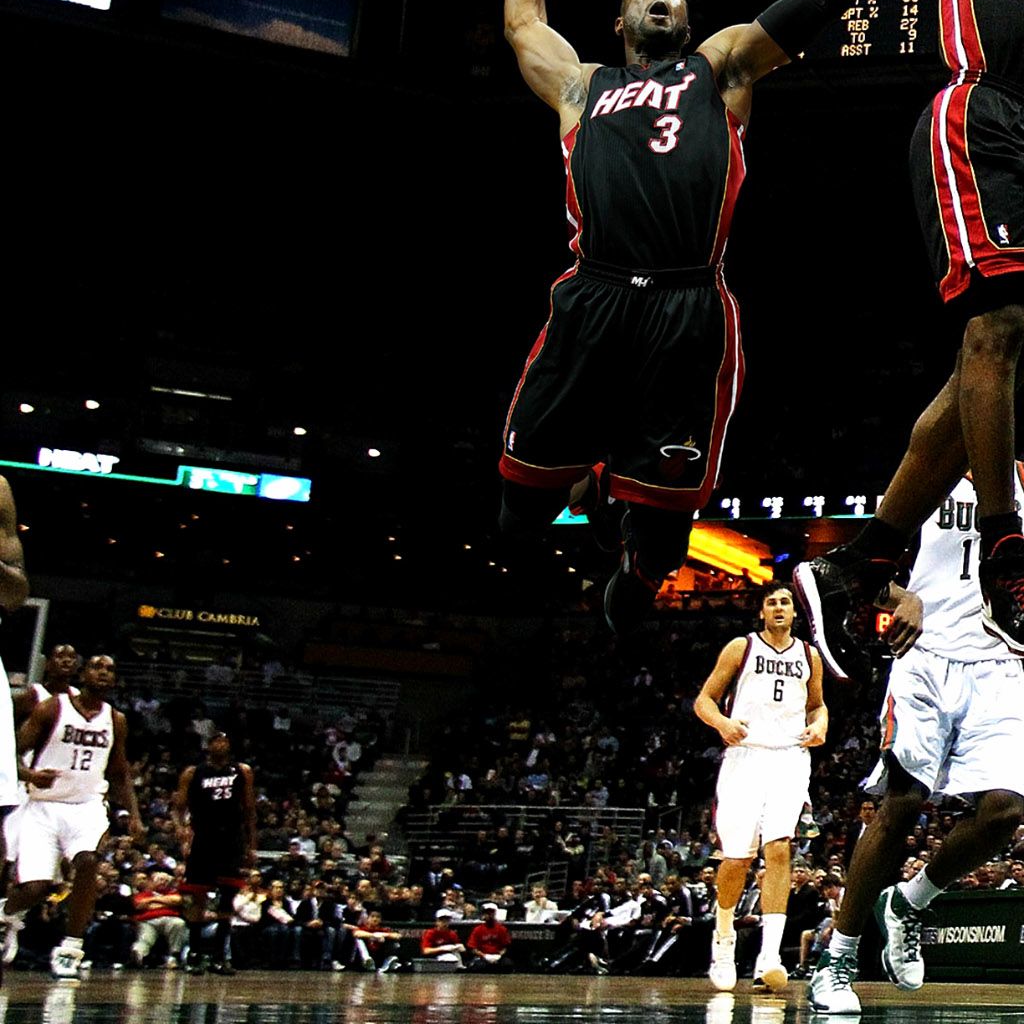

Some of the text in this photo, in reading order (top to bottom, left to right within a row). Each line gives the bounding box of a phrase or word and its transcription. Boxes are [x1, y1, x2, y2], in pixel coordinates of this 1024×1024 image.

[902, 4, 919, 17] 14
[847, 17, 918, 32] REB 27
[850, 29, 918, 44] TO 9
[840, 41, 915, 57] ASST 11
[590, 72, 697, 120] HEAT
[648, 112, 684, 155] 3
[158, 607, 194, 622] CLUB
[754, 655, 804, 680] BUCKS
[773, 678, 785, 703] 6
[61, 724, 109, 749] BUCKS
[70, 748, 93, 771] 12
[202, 774, 238, 789] HEAT
[213, 787, 233, 800] 25
